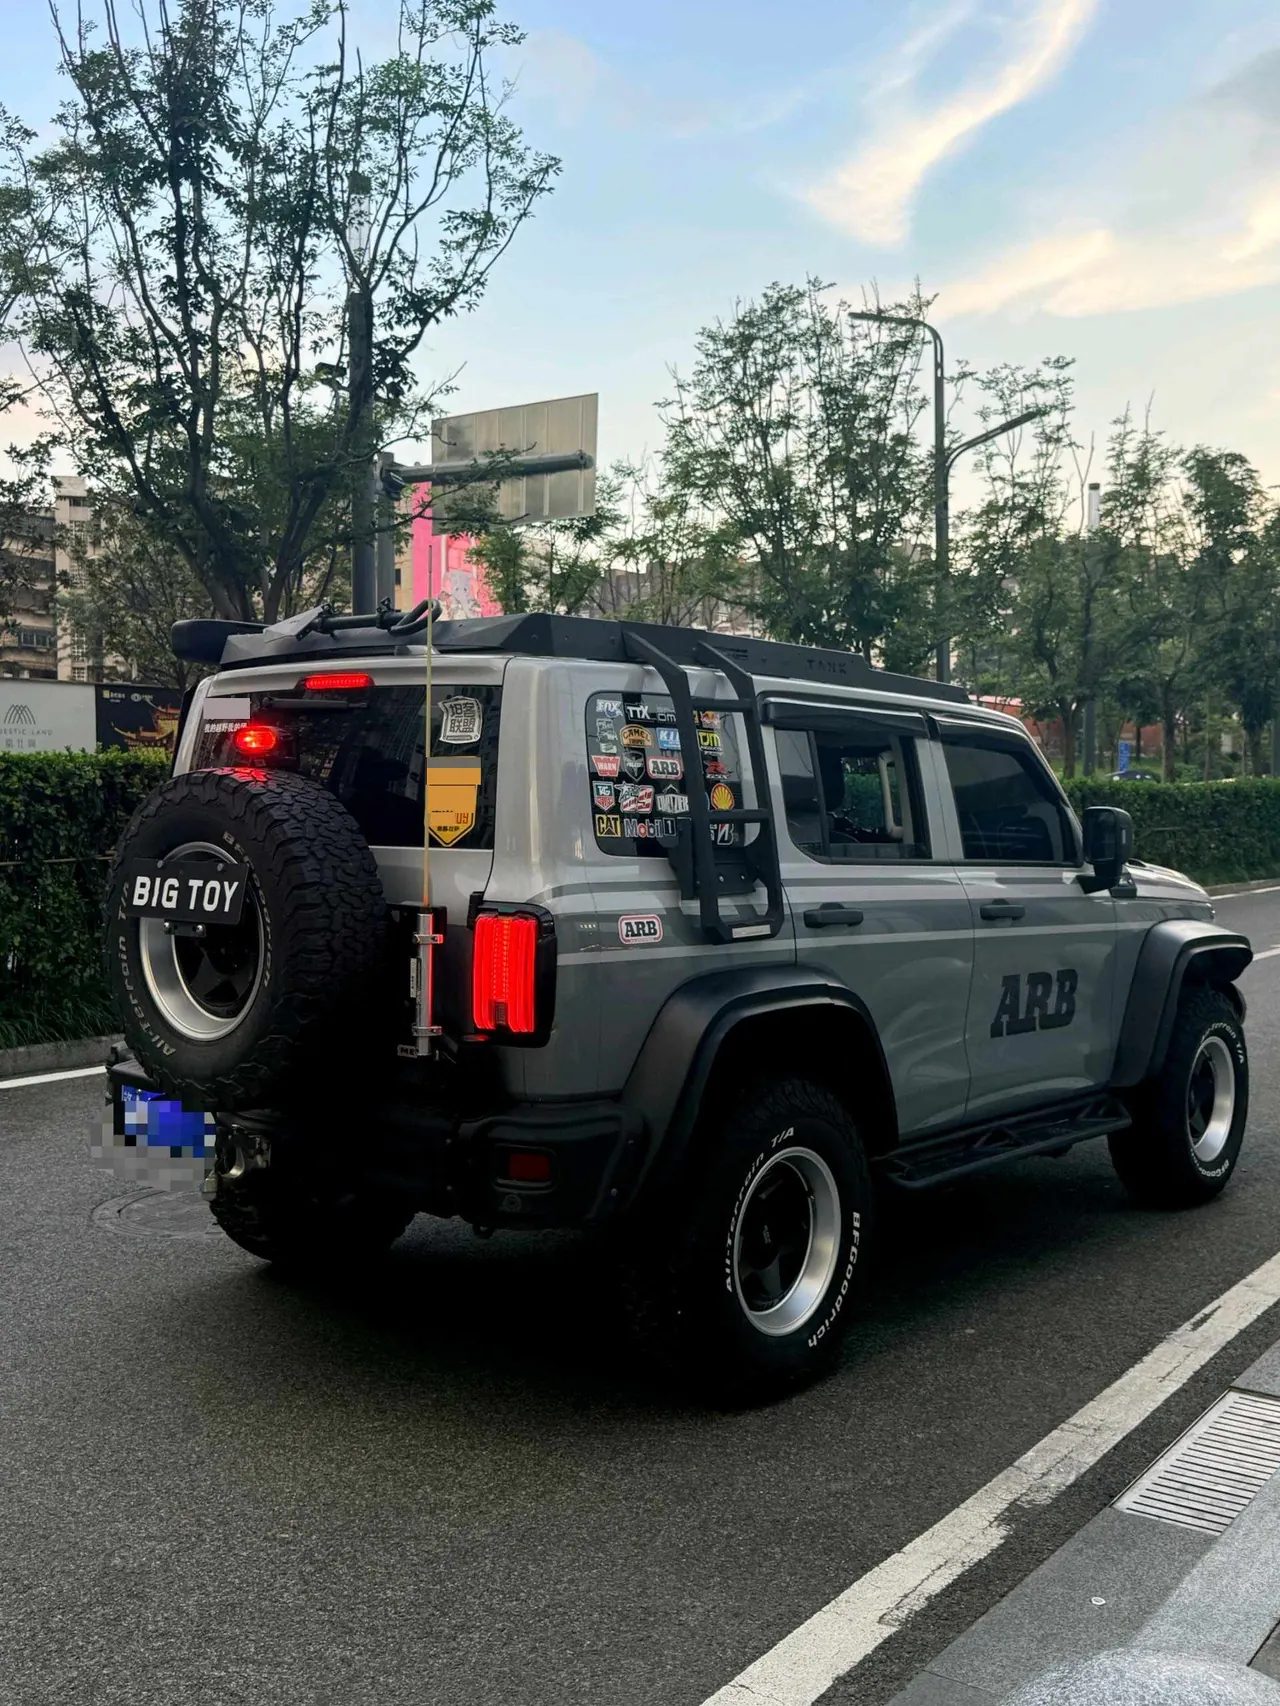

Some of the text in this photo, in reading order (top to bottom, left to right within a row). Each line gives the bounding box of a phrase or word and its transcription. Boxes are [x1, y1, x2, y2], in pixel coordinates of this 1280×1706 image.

[806, 659, 847, 675] TANK
[626, 705, 651, 719] TTX
[31, 729, 53, 737] LAND
[622, 729, 651, 743] CAMEL
[597, 762, 617, 771] WARN
[651, 760, 680, 775] ARB
[597, 816, 620, 836] CAT
[624, 819, 663, 838] Mobil
[132, 876, 239, 913] BIG TOY
[624, 920, 658, 937] ARB
[990, 968, 1078, 1038] ARB
[770, 1126, 795, 1148] T/A
[807, 1211, 861, 1349] BFGoodrich
